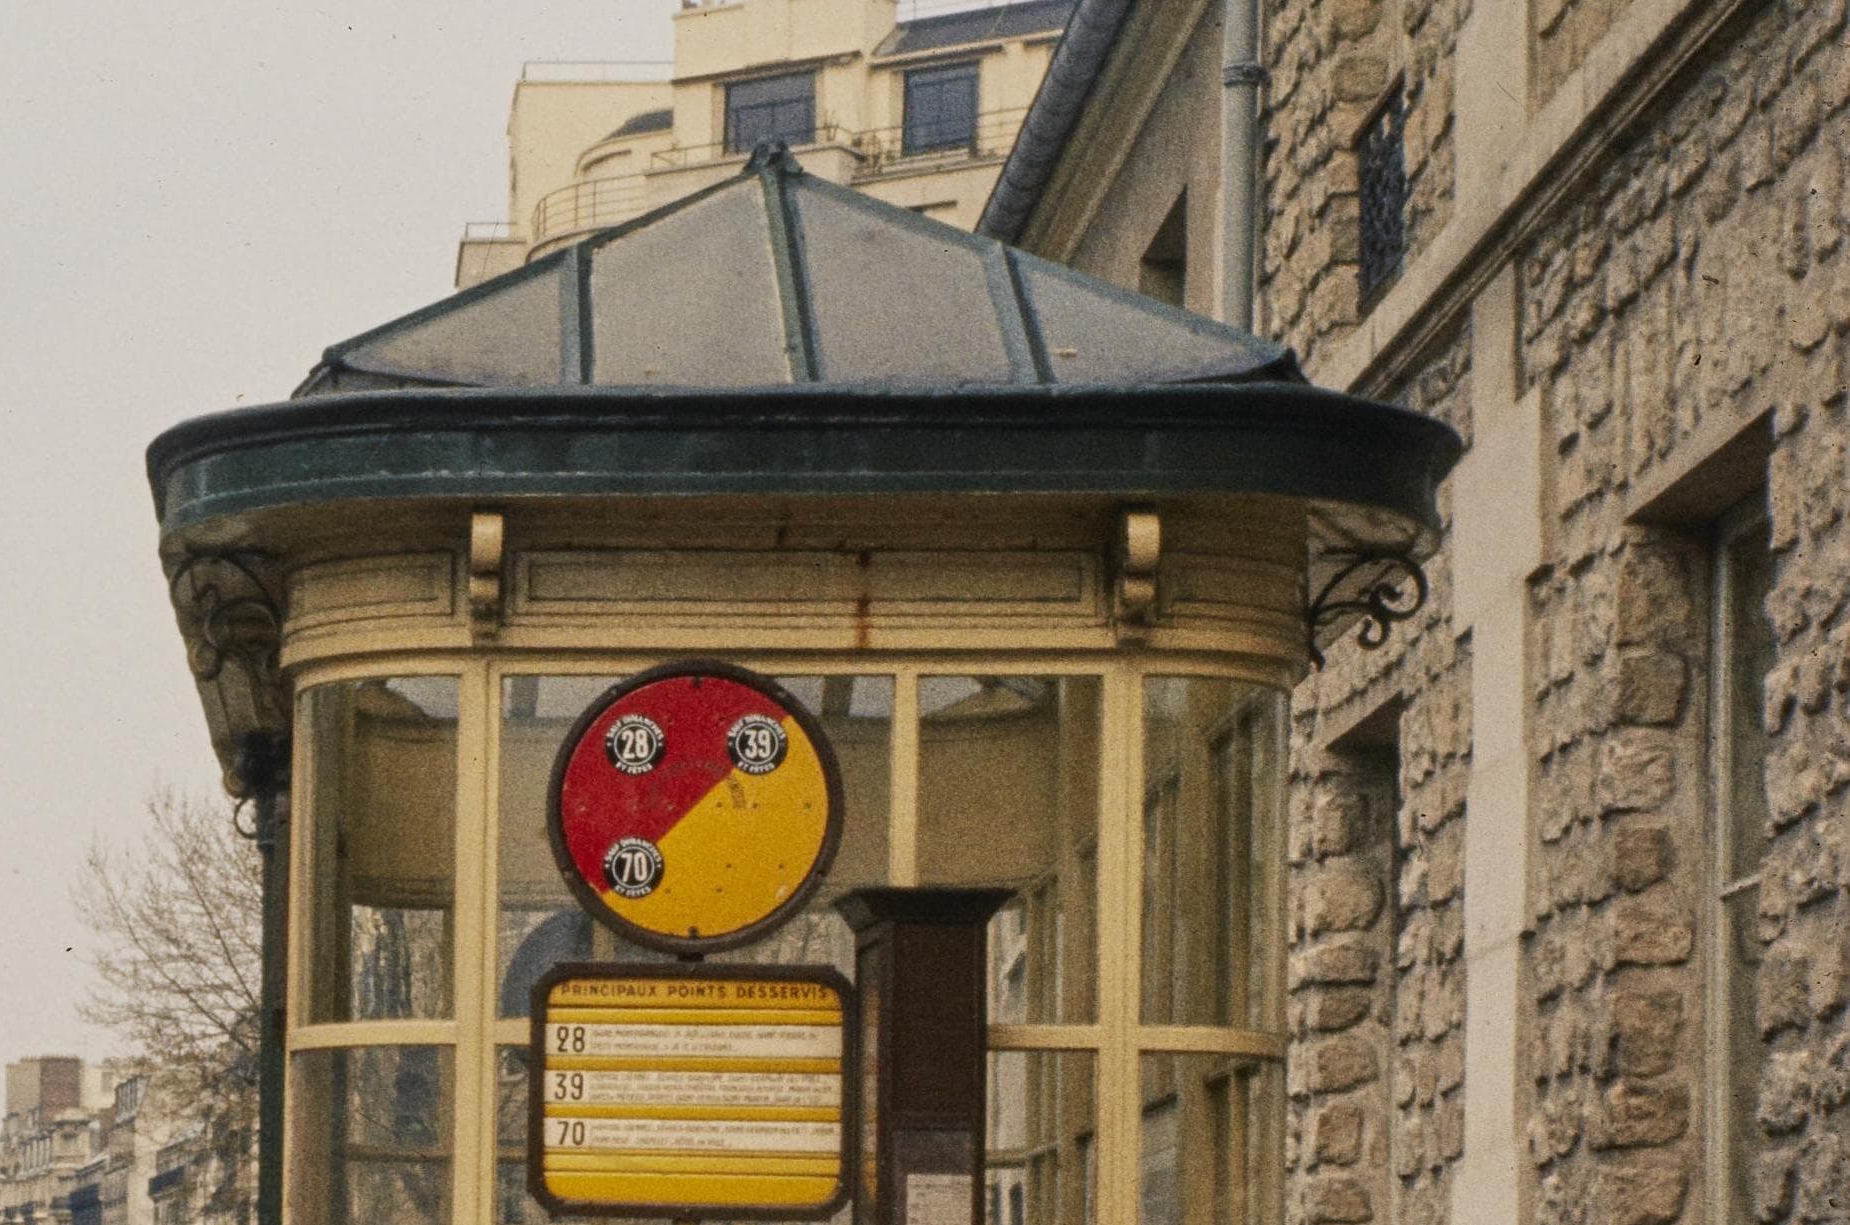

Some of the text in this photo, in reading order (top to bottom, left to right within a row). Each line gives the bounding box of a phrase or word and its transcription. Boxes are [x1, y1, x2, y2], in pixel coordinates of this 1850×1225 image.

[621, 729, 649, 759] 28
[744, 729, 771, 759] 39
[621, 851, 648, 882] 70
[560, 983, 828, 1000] PRINCIPAUX POINTS DESSERVIS
[556, 1026, 586, 1053] 28
[554, 1073, 584, 1100] 39
[557, 1121, 586, 1146] 70
